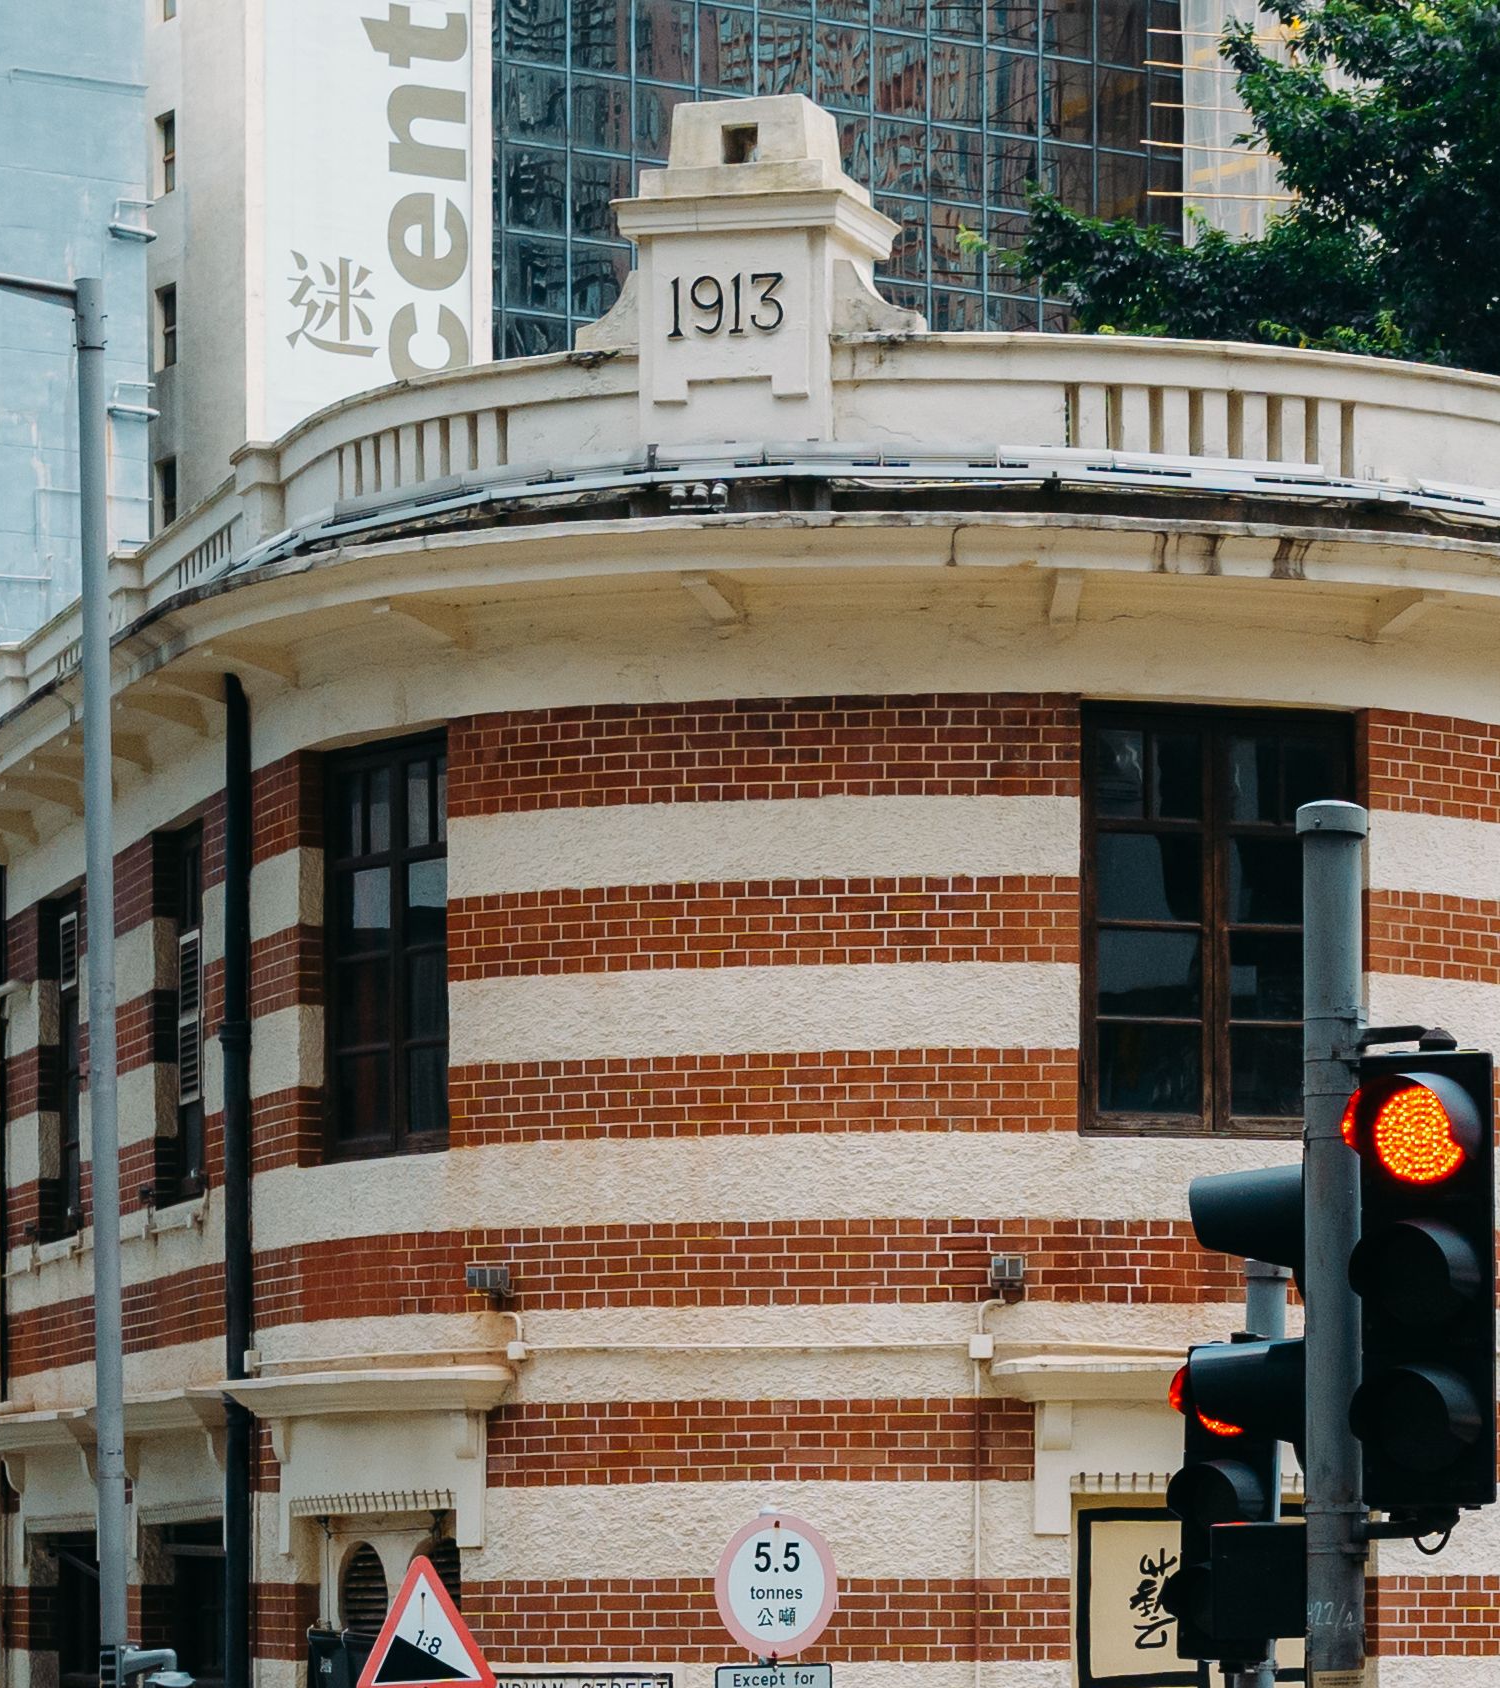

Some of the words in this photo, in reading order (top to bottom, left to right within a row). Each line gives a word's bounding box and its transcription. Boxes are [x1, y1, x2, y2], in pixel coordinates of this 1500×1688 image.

[286, 250, 381, 358] 迷
[668, 272, 784, 340] 1913
[754, 1542, 800, 1573] 5.5
[750, 1586, 803, 1601] tonnes
[415, 1629, 442, 1656] 1:8
[733, 1672, 786, 1688] Except
[794, 1670, 815, 1686] for
